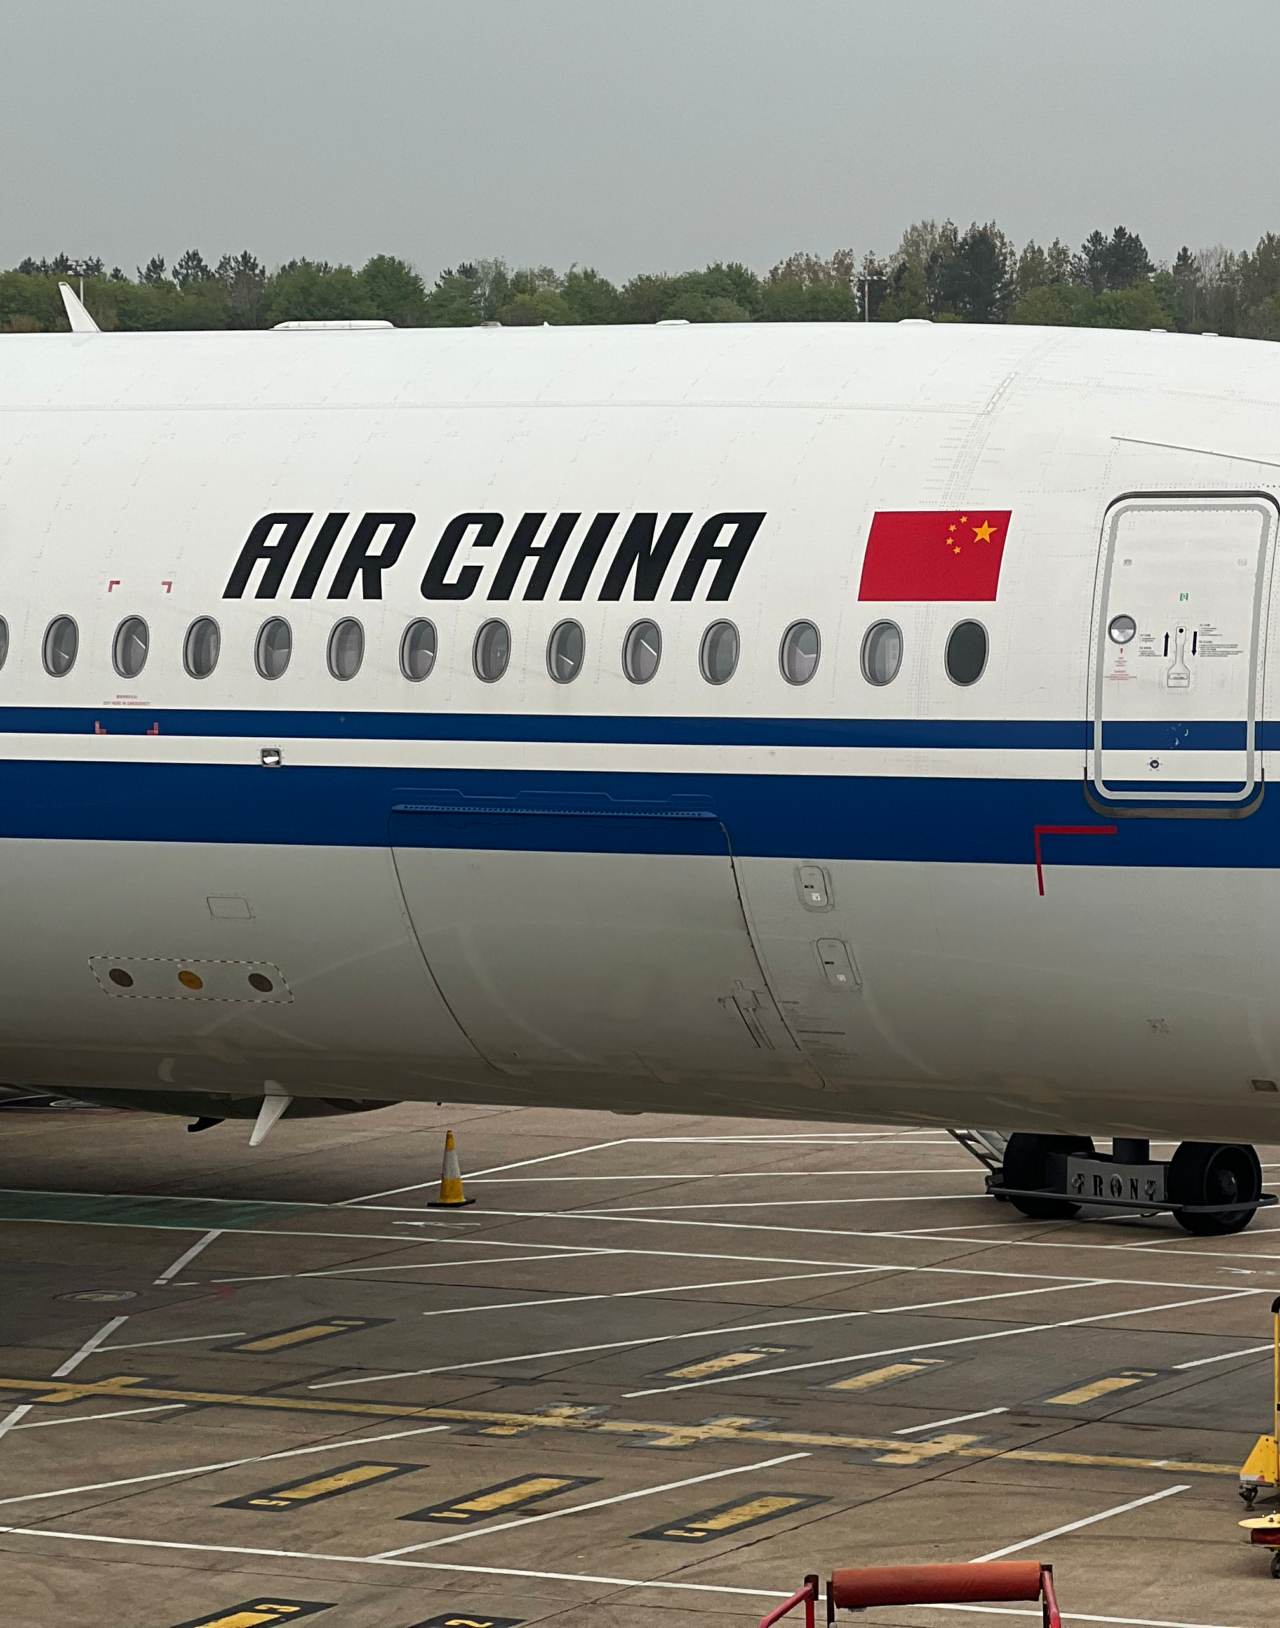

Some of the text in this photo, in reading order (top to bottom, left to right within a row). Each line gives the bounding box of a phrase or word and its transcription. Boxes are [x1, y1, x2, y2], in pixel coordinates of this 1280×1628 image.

[222, 512, 767, 601] AIR CHINA
[1076, 1173, 1157, 1201] FRONT
